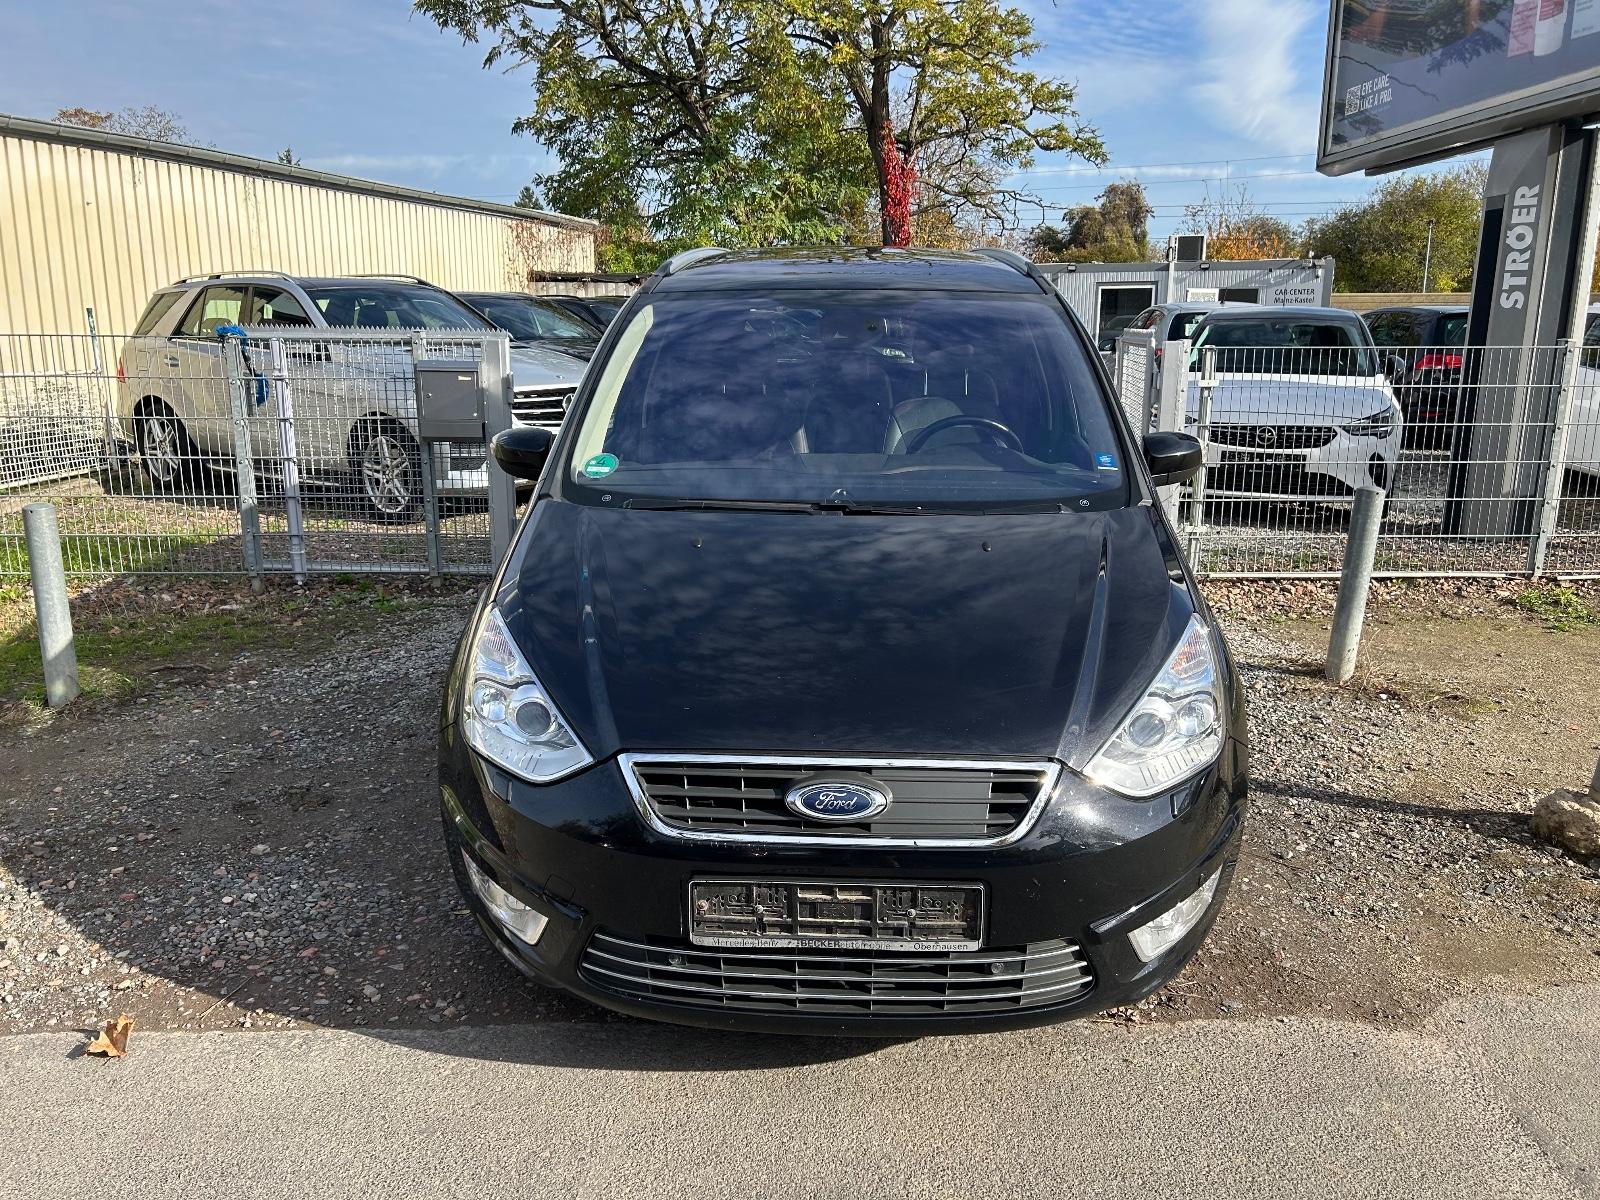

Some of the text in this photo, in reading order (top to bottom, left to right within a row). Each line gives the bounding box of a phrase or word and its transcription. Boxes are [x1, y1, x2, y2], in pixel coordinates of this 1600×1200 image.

[1361, 73, 1390, 96] EYE CARE
[1360, 95, 1373, 111] LIKE
[1373, 94, 1378, 106] A
[1499, 184, 1540, 310] STRÖER
[597, 456, 606, 466] 4
[815, 791, 858, 810] Ford
[913, 942, 968, 951] Oberhausen
